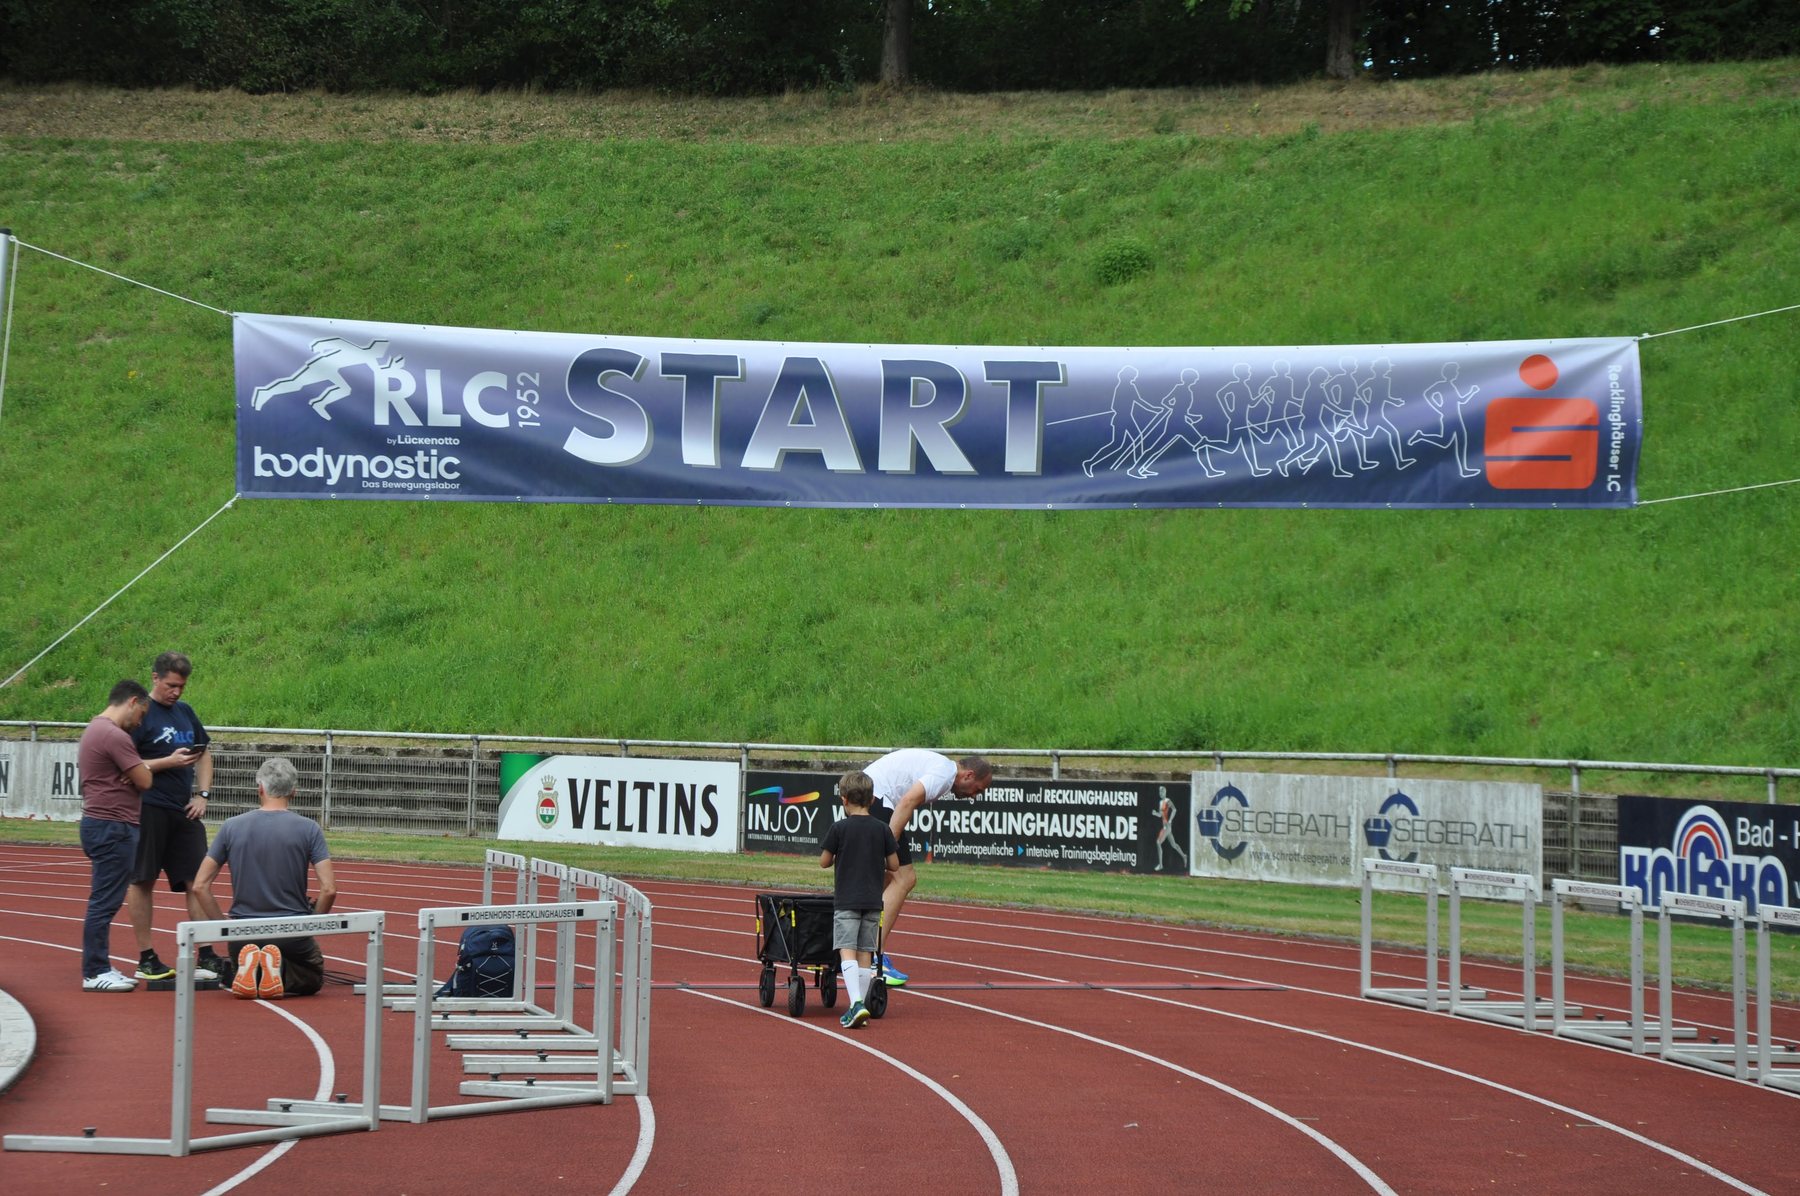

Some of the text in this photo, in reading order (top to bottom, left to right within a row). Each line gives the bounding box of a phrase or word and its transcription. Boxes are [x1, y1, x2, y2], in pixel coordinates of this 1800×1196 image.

[373, 367, 509, 428] RLC
[517, 371, 541, 428] 1952
[564, 347, 1066, 474] START
[387, 434, 460, 446] by Lückenotto
[1607, 364, 1627, 492] Recklinghäuser LC
[254, 446, 461, 485] bodynostic
[362, 480, 460, 491] Das Bewegungslabor
[567, 777, 719, 838] VELTINS
[984, 787, 1024, 802] HERTEN
[1026, 787, 1042, 803] und
[1044, 789, 1138, 806] RECKLINGHAUSEN
[747, 803, 819, 834] INJOY
[904, 808, 1138, 840] JOY-RECKLINGHAUSEN.DE
[1225, 809, 1351, 839] SEGERATH
[1394, 818, 1529, 849] SEGERATH
[1737, 816, 1774, 848] Bad
[933, 838, 1014, 859] physiotherapeutische
[1026, 844, 1059, 859] intensive
[1060, 844, 1137, 867] Trainingsbegleitung
[230, 920, 340, 936] HOHENHORST-RECKLINGHAUSEN
[470, 909, 576, 921] HOHENHORST-RECKLINGHAUSEN
